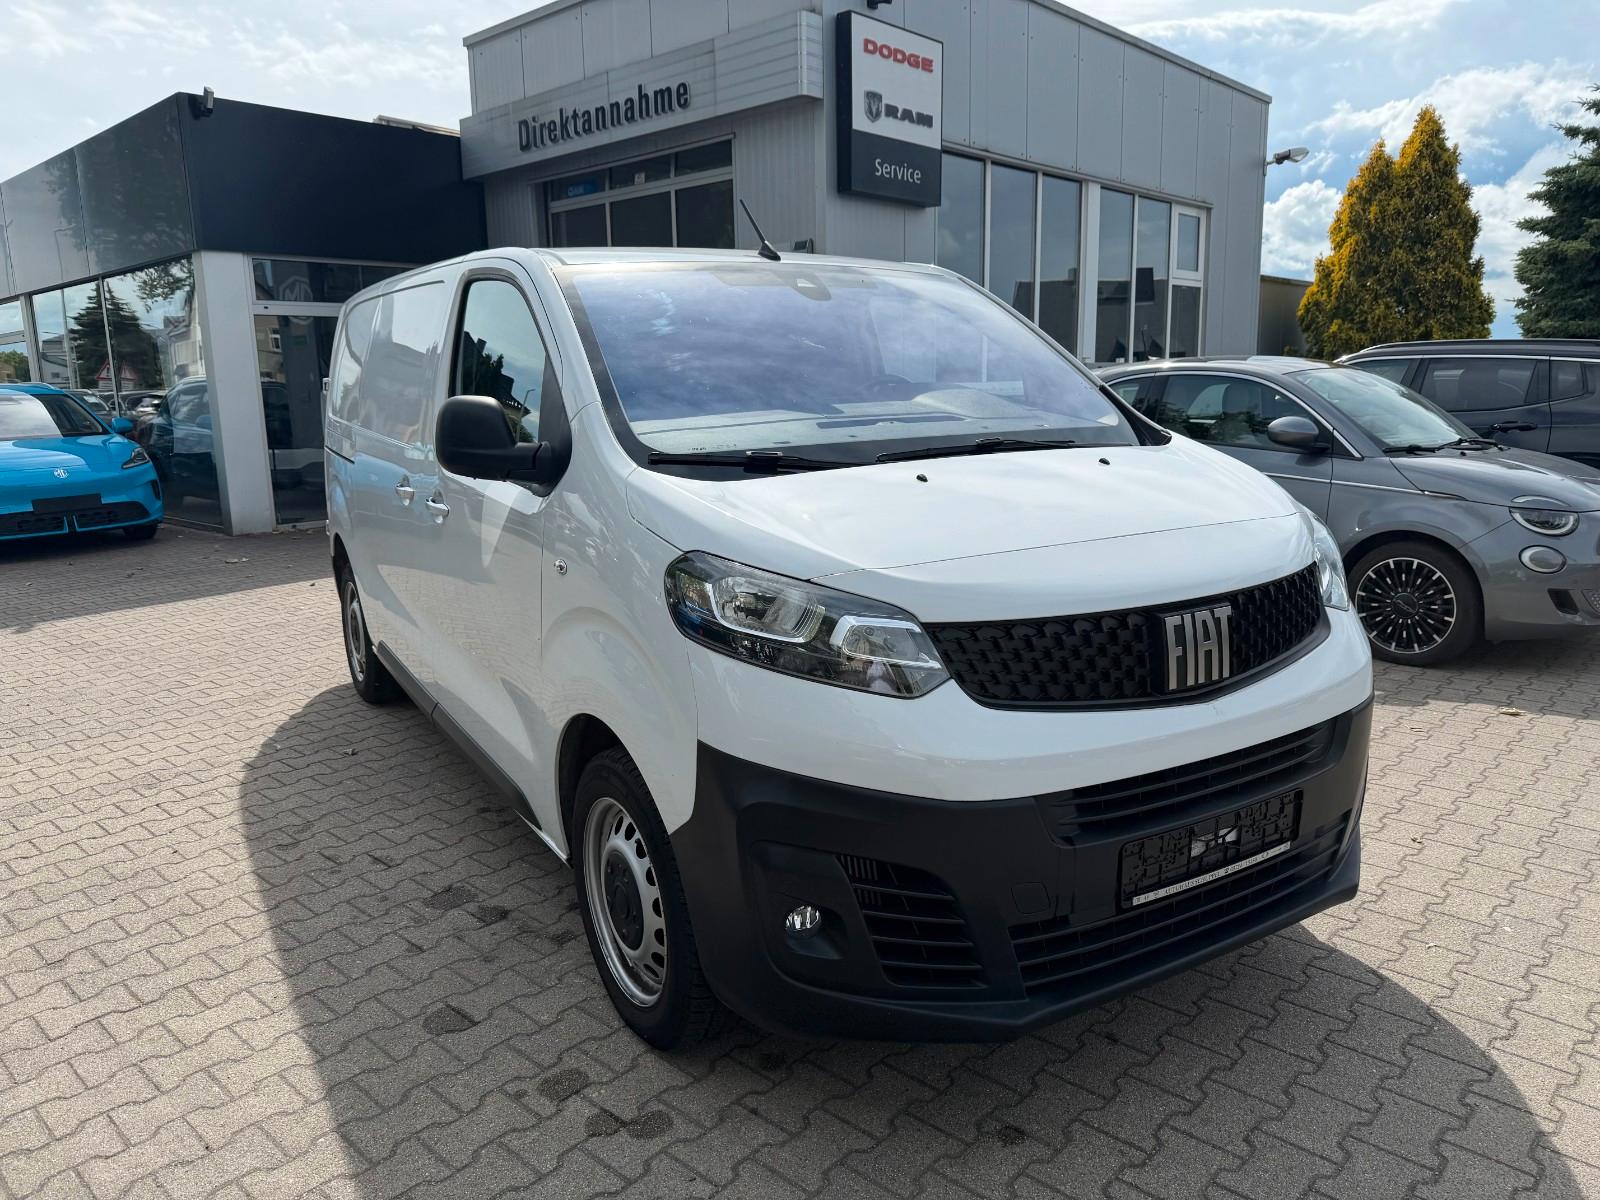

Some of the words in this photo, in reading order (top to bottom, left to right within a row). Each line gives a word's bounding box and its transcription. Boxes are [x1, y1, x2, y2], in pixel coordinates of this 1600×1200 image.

[863, 38, 934, 73] DODGE
[518, 81, 690, 152] Direktannahme
[884, 103, 934, 129] RAM
[875, 158, 921, 184] Service
[1164, 605, 1232, 691] FIAT
